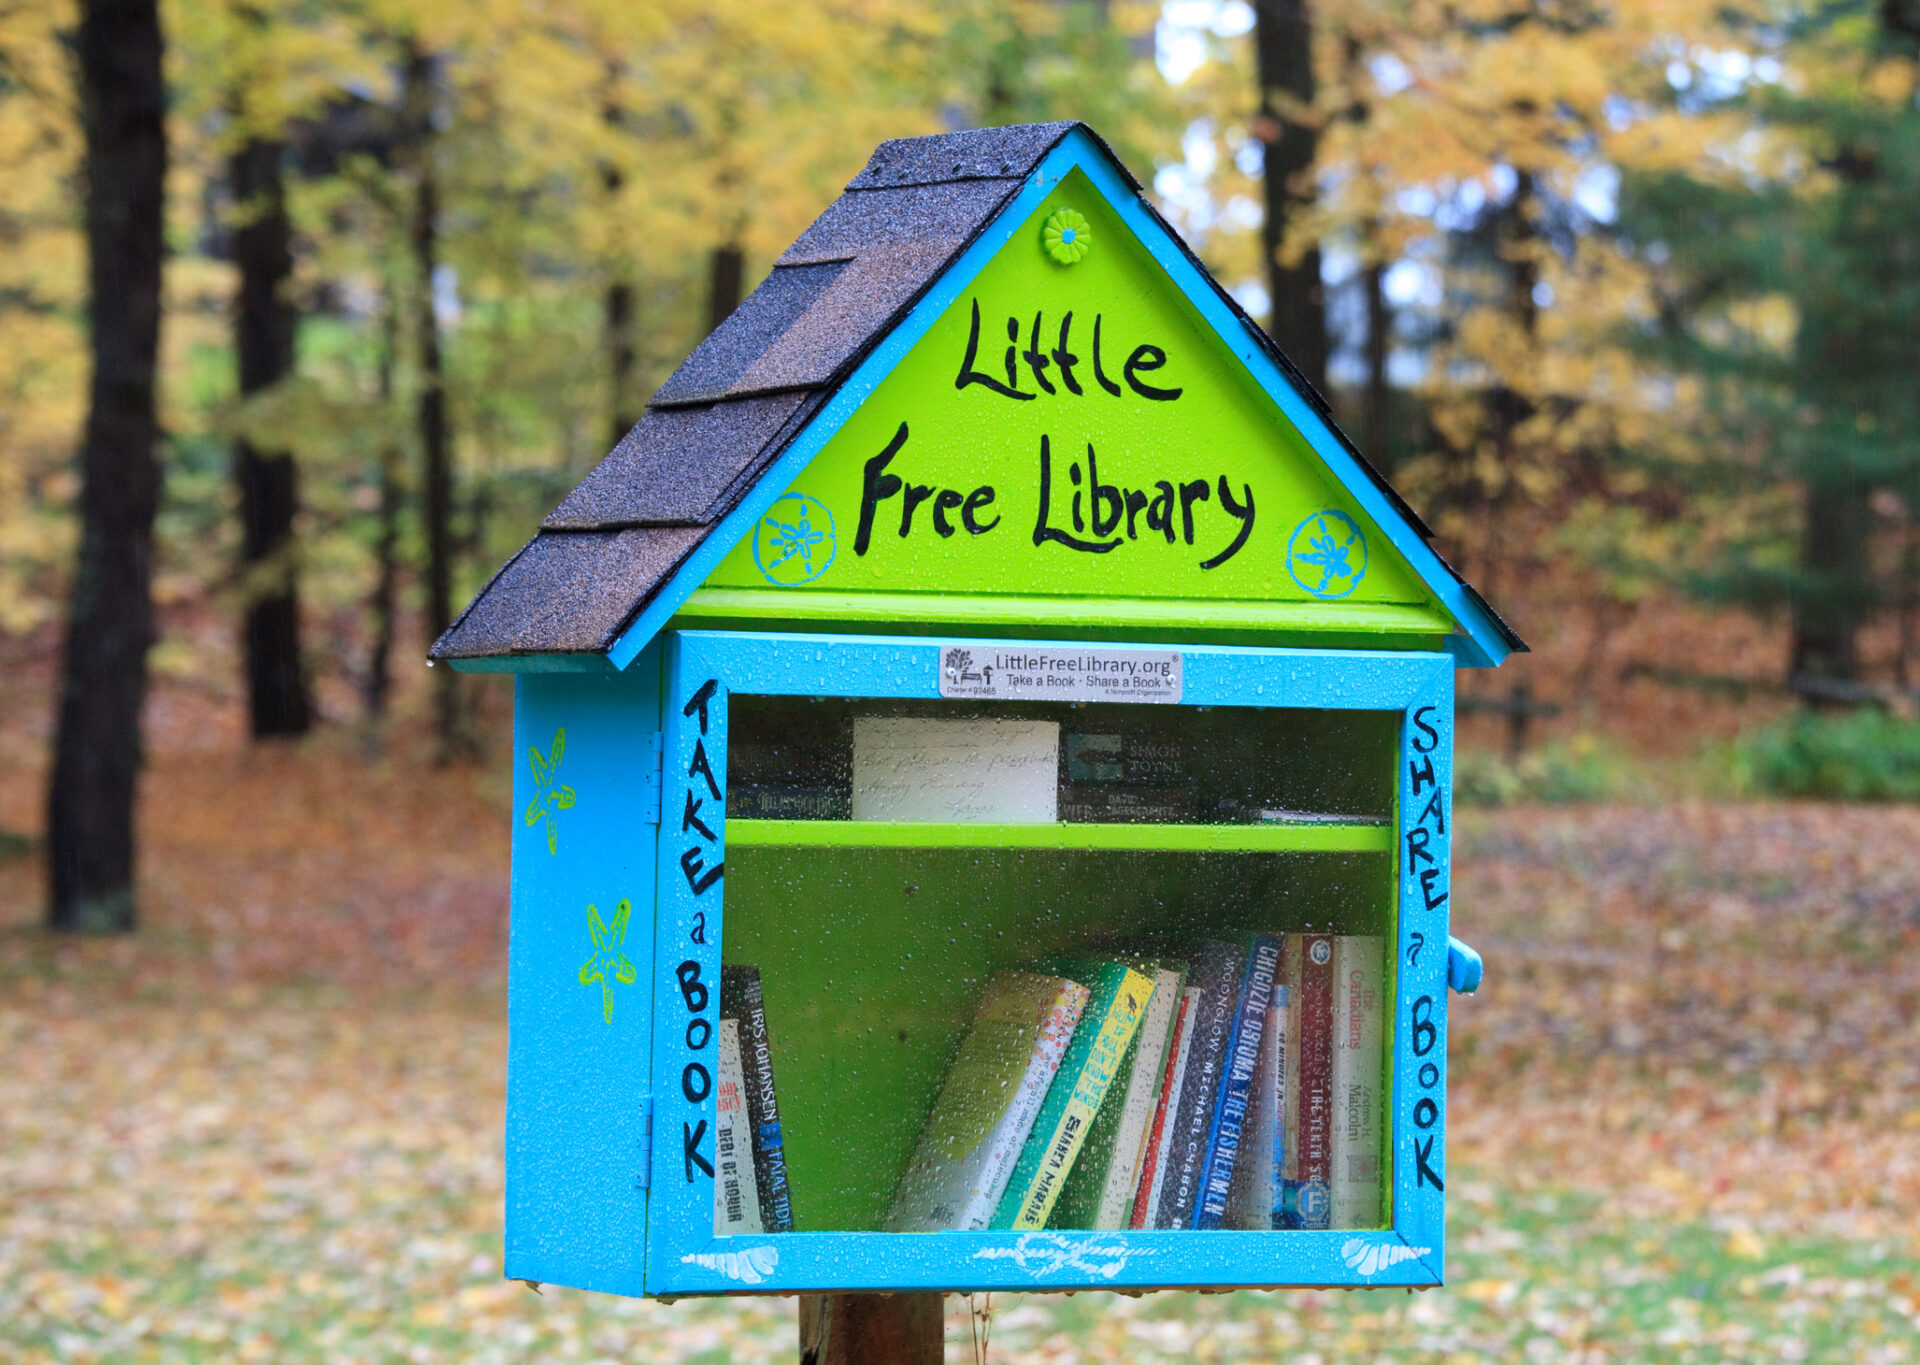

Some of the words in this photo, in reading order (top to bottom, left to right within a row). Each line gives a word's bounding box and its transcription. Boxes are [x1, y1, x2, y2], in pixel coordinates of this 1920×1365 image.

[955, 296, 1183, 401] Little
[853, 421, 1001, 556] Free
[1032, 434, 1255, 570] Library
[1006, 674, 1033, 686] Take
[1036, 677, 1044, 686] a
[1046, 675, 1075, 687] Book
[1086, 675, 1120, 687] Share
[1122, 678, 1129, 688] a
[1133, 676, 1161, 688] Book
[1129, 745, 1181, 758] SIMON
[681, 679, 724, 896] TAKE
[1406, 706, 1448, 911] SHARE
[690, 911, 706, 944] a
[1208, 958, 1235, 1051] MOONGLOW
[1245, 945, 1278, 1017] CHIGOZIE
[1348, 970, 1364, 1049] Canadians
[1363, 989, 1375, 1010] The
[749, 1008, 766, 1038] IRIS
[1231, 1018, 1262, 1082] OBIOMA
[676, 960, 715, 1183] BOOK
[753, 1042, 777, 1120] JOHANSEN
[1191, 1061, 1214, 1135] MICHAEL
[1224, 1089, 1249, 1119] THE
[1310, 1088, 1323, 1114] THE
[1412, 995, 1444, 1192] BOOK
[718, 1127, 734, 1157] DEBT
[1049, 1115, 1081, 1168] BIANCA
[1309, 1118, 1323, 1158] TENTH
[1347, 1083, 1362, 1141] Malcolm
[1024, 1170, 1055, 1226] MARAIS
[1176, 1142, 1196, 1208] CHABON
[1204, 1120, 1240, 1216] FISHERMEN
